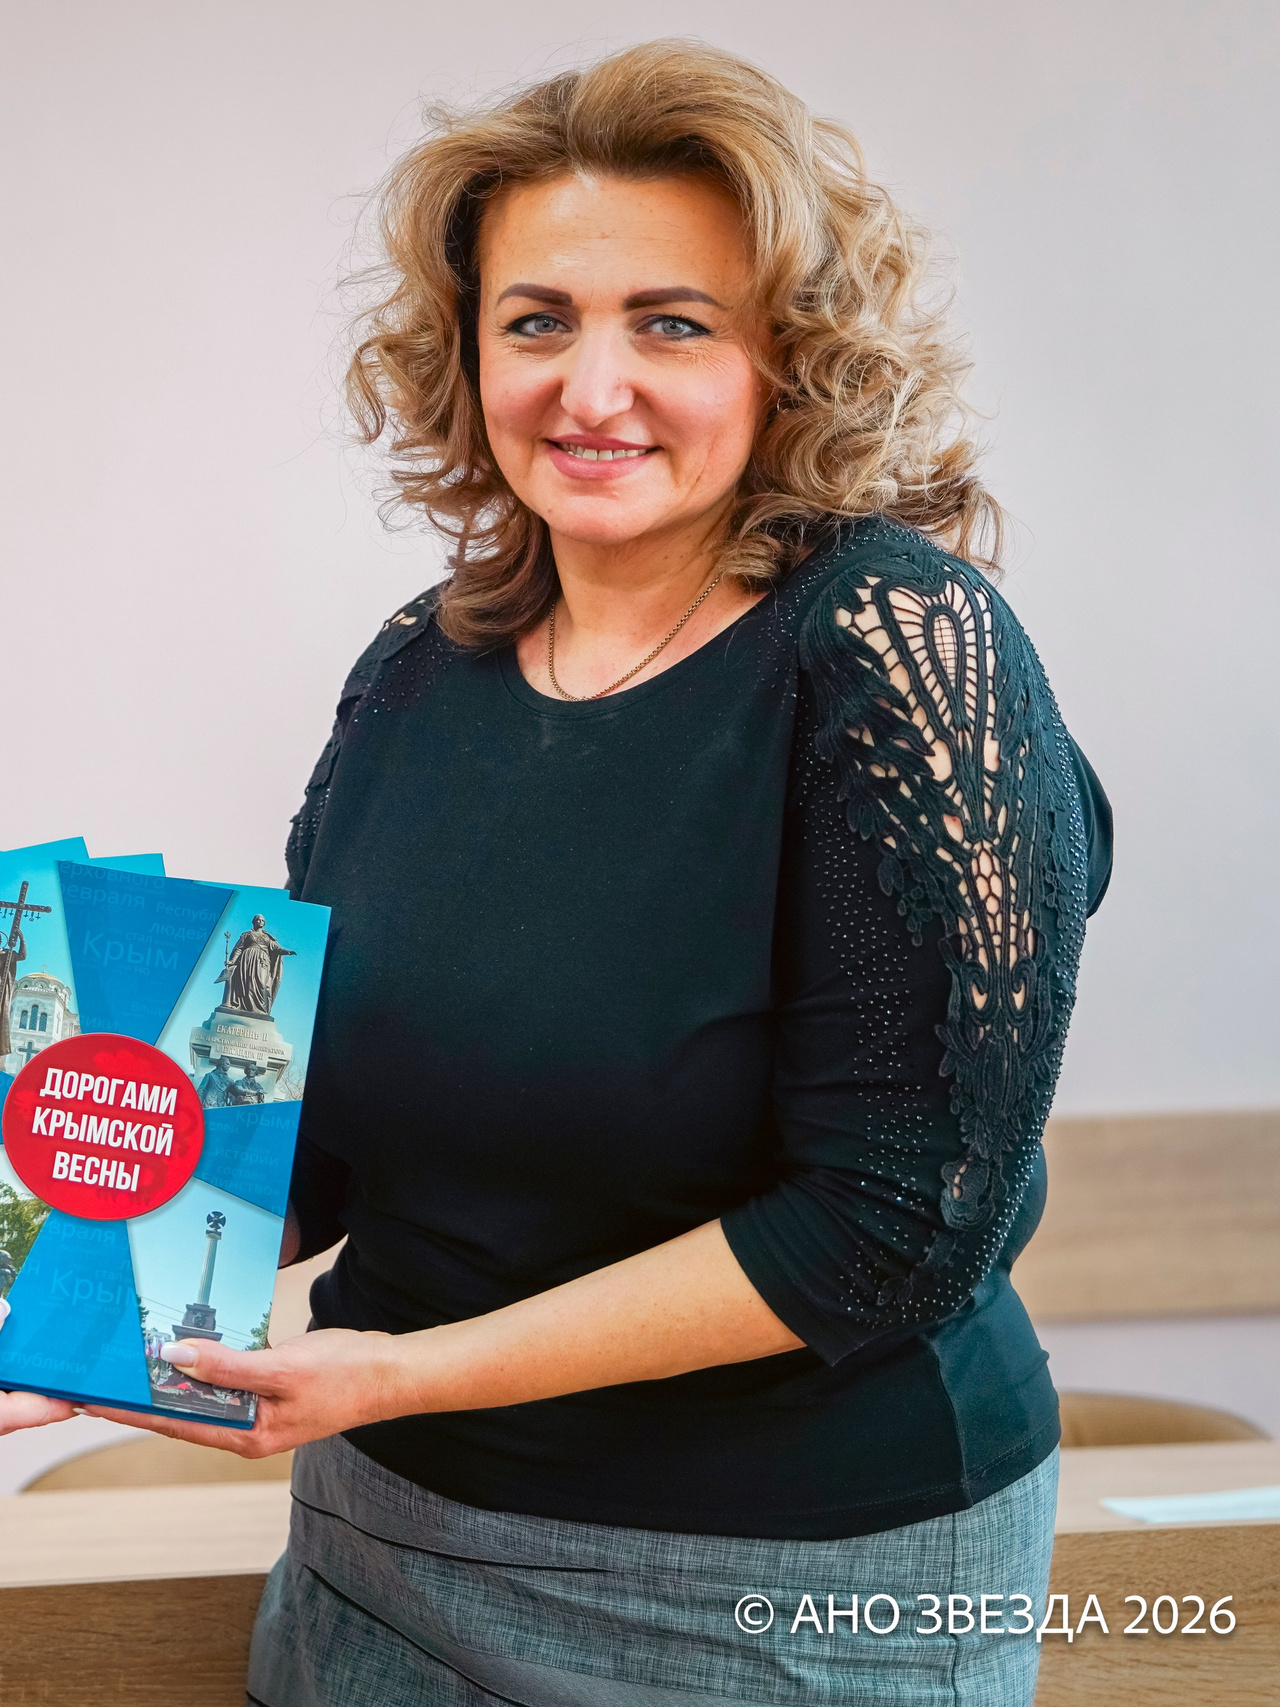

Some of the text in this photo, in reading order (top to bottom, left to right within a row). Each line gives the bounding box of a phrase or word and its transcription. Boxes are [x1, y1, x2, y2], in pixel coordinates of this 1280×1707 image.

[82, 929, 179, 971] Крым
[149, 922, 207, 942] людей
[39, 1067, 178, 1116] ДОРОГАМИ
[31, 1106, 174, 1156] КРЫМСКОЙ
[52, 1151, 141, 1192] ВЕСНЫ
